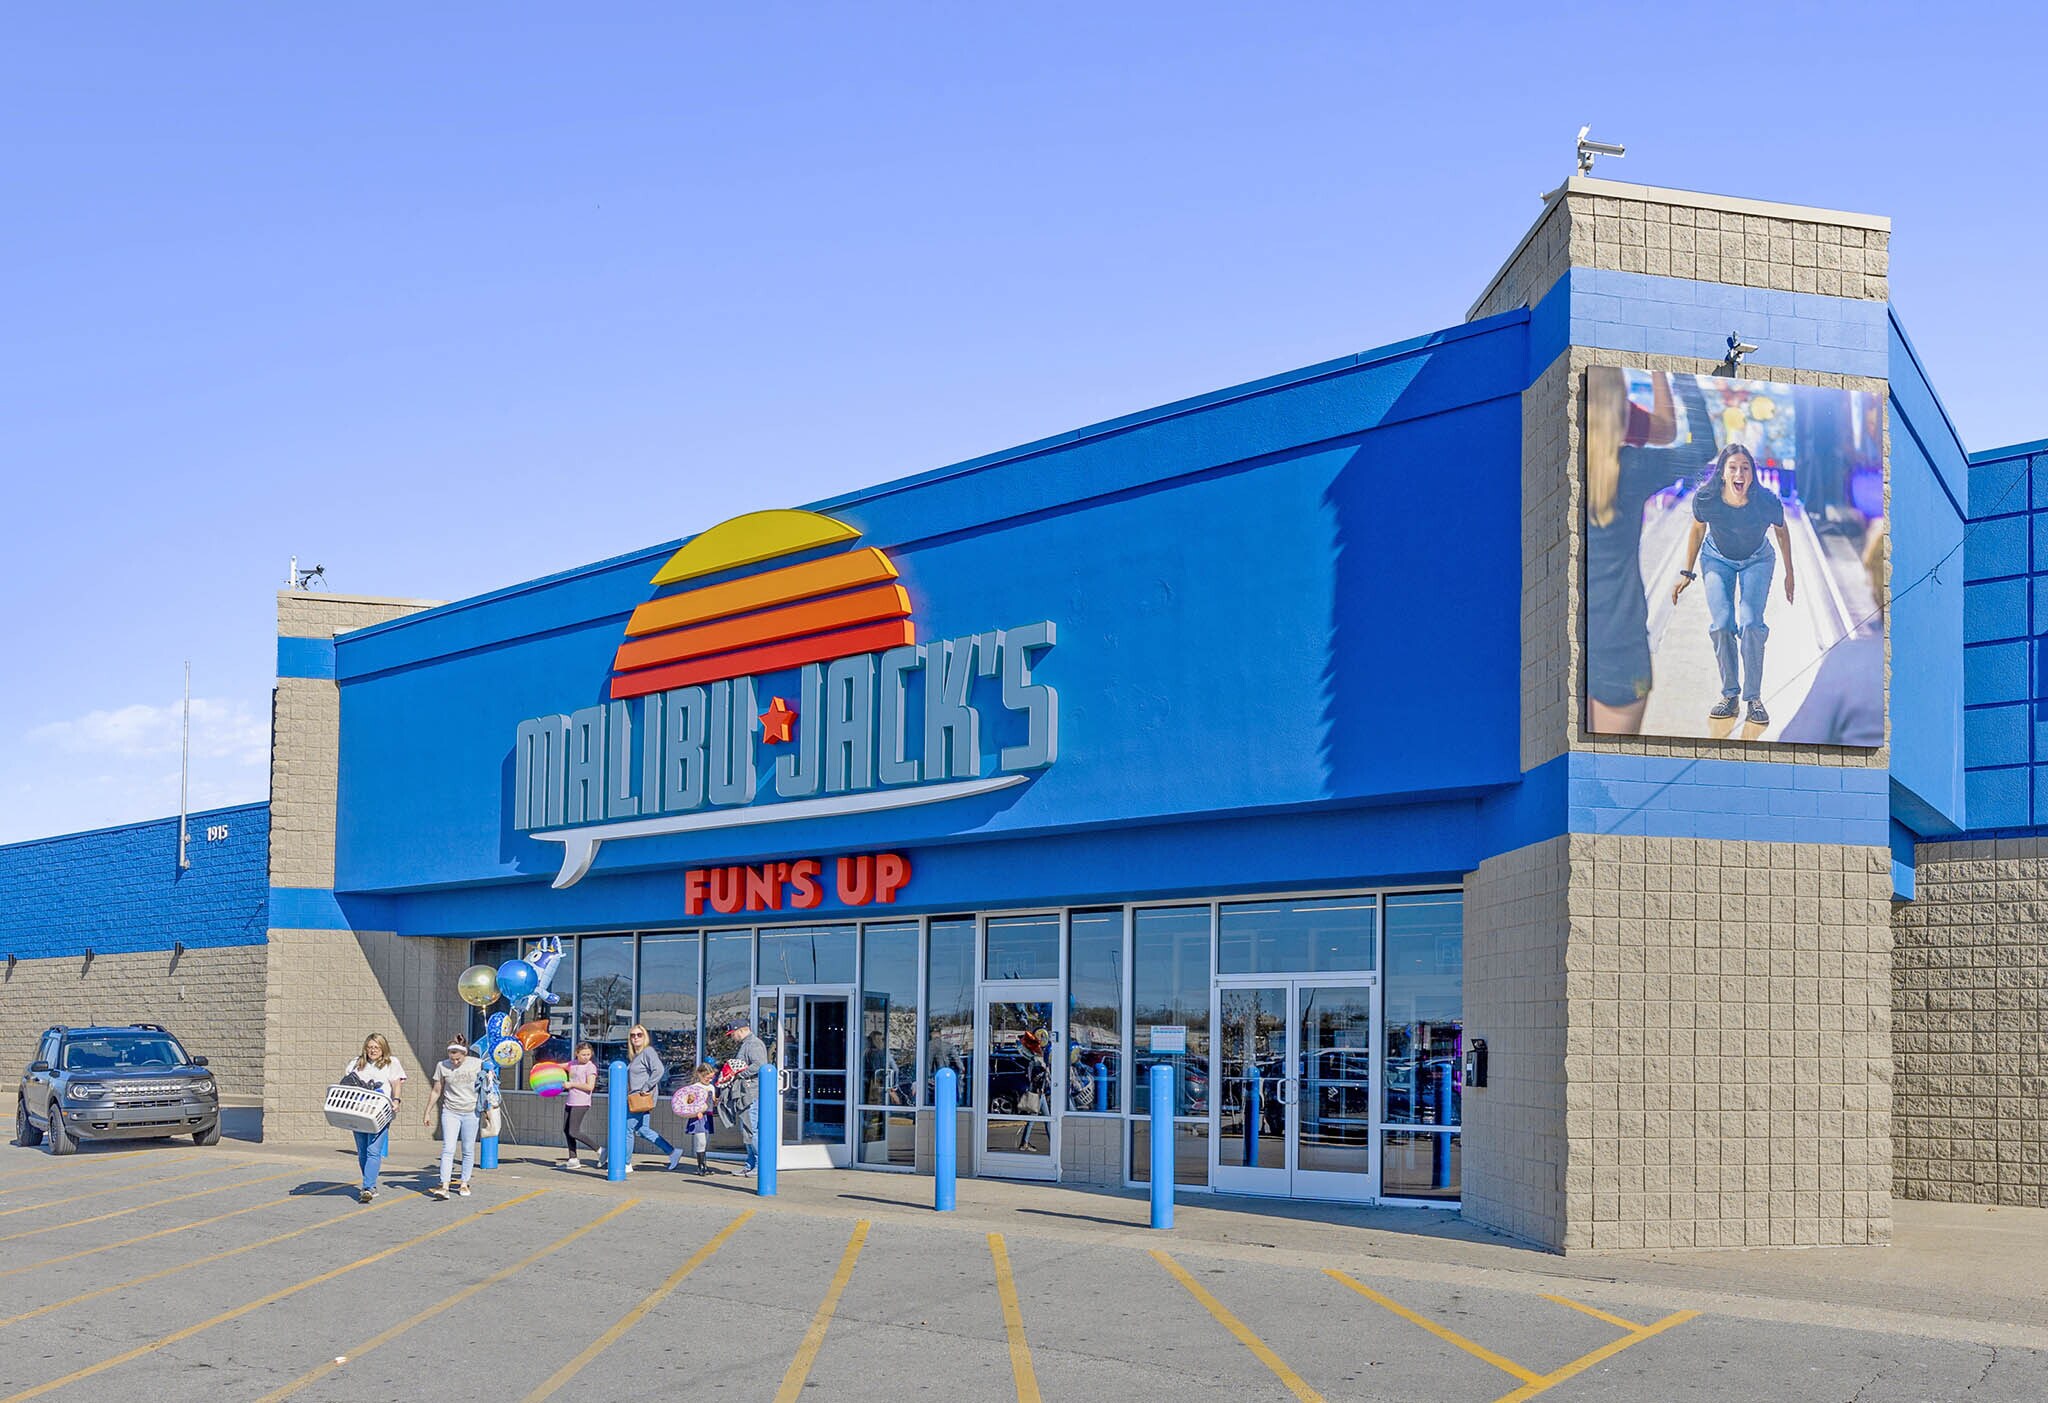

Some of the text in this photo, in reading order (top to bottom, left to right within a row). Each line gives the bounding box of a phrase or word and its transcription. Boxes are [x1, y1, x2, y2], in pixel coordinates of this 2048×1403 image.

[514, 620, 1059, 831] MALIBU JACK'S
[207, 824, 228, 842] 1915
[684, 853, 912, 916] FUN'S UP
